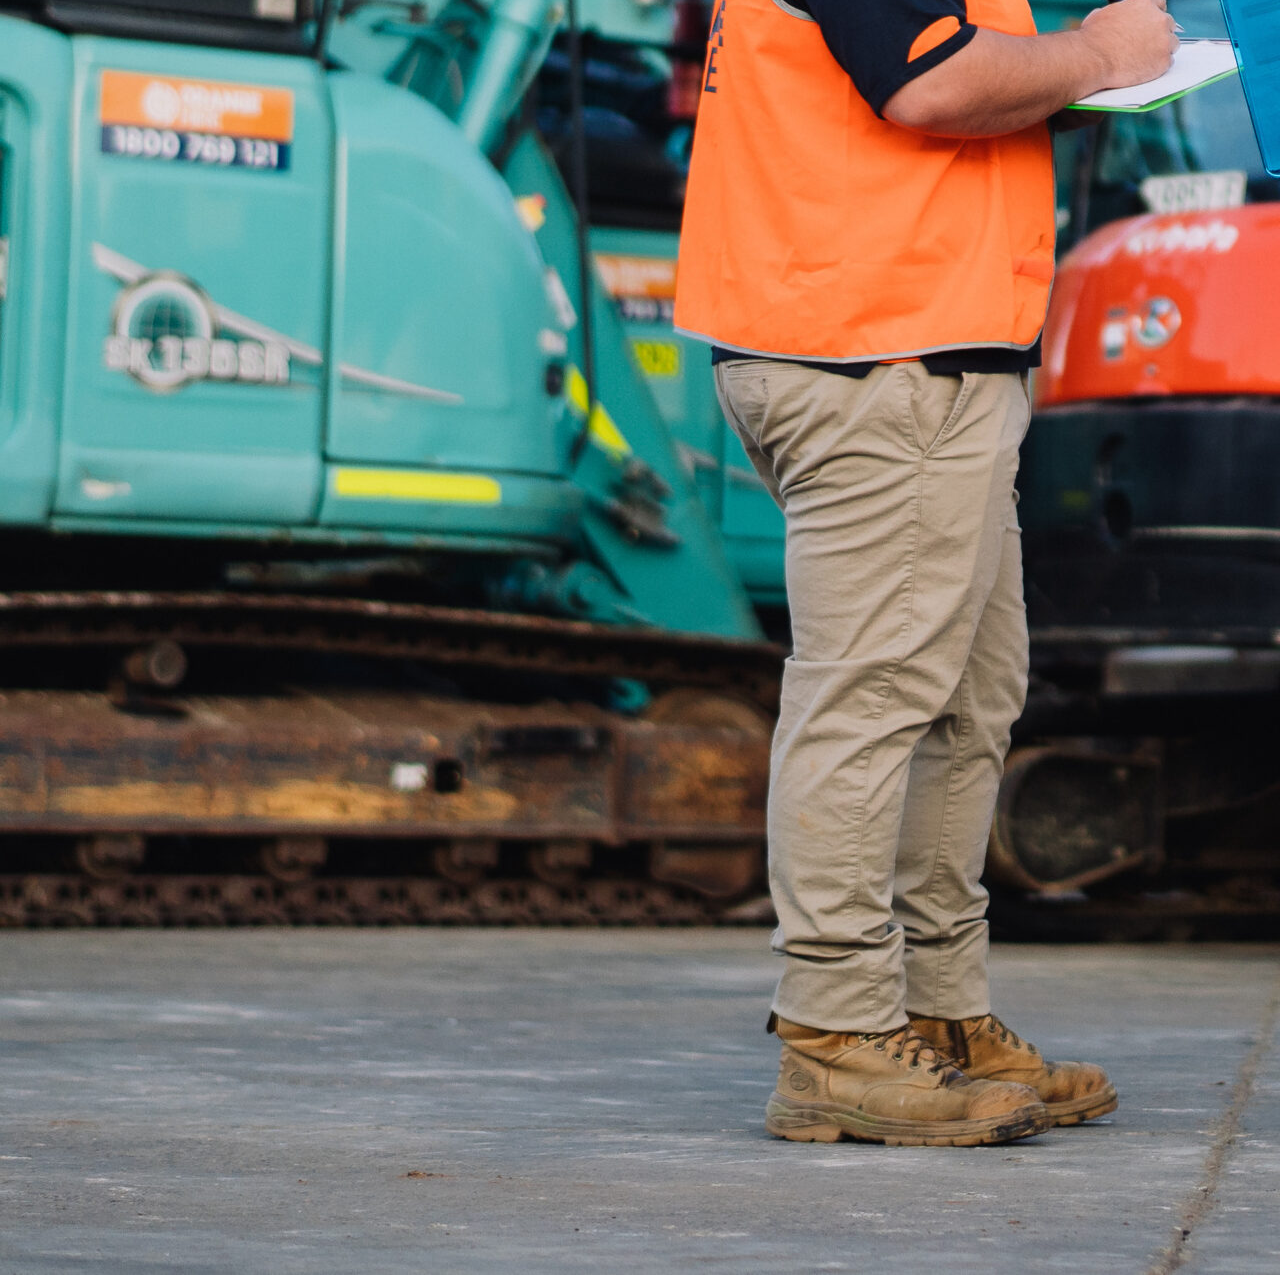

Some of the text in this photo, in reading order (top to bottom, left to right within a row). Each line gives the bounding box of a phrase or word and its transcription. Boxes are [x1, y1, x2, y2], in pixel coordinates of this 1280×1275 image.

[112, 124, 280, 169] 1800 769 121
